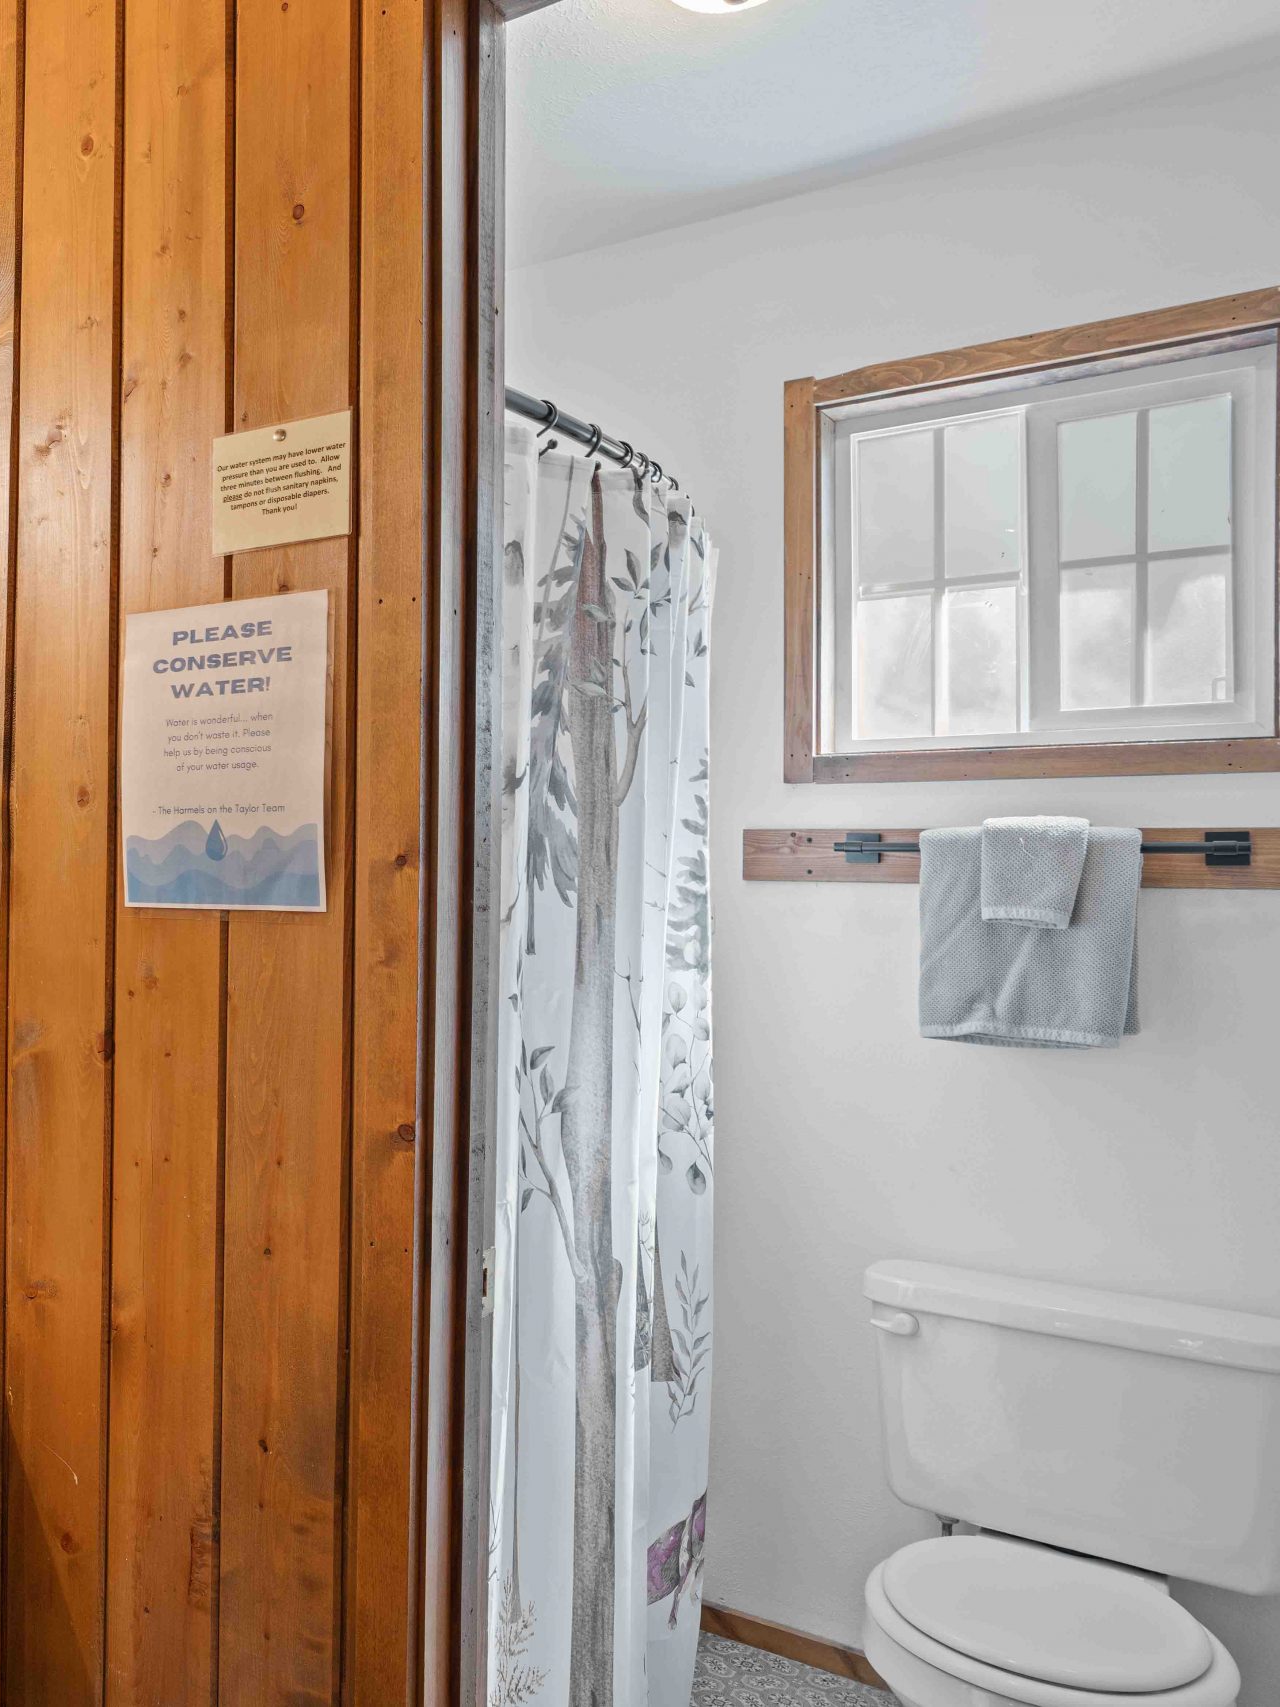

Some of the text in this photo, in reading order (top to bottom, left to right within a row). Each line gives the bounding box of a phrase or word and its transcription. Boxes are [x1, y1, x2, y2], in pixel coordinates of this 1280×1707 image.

[229, 461, 248, 470] water
[249, 456, 271, 467] system
[288, 450, 304, 458] have
[305, 446, 325, 455] lower
[325, 442, 347, 451] water
[220, 463, 342, 492] three minutes between flushing. And
[222, 471, 248, 482] pressure
[249, 468, 264, 476] than
[265, 466, 278, 474] you
[290, 459, 307, 468] used
[320, 454, 340, 463] Allow
[222, 493, 243, 503] please
[253, 488, 265, 496] not
[265, 485, 282, 494] flush
[282, 481, 310, 491] sanitary
[230, 501, 258, 511] tampons
[267, 492, 302, 504] disposable
[302, 488, 330, 498] diapers.
[261, 503, 298, 516] Thank you!
[172, 620, 273, 646] PLEASE
[152, 646, 293, 674] CONSERVE
[170, 676, 271, 699] WATER!
[166, 711, 273, 727] Water is wonderful... when
[167, 728, 272, 744] you don't waste it. Please
[163, 748, 181, 759] help
[193, 747, 204, 758] by
[205, 746, 229, 757] being
[230, 745, 273, 754] conscious
[176, 761, 259, 774] of your water usage.
[158, 806, 172, 815] The
[219, 803, 233, 814] the
[234, 803, 260, 816] Taylor
[261, 803, 286, 813] Team
